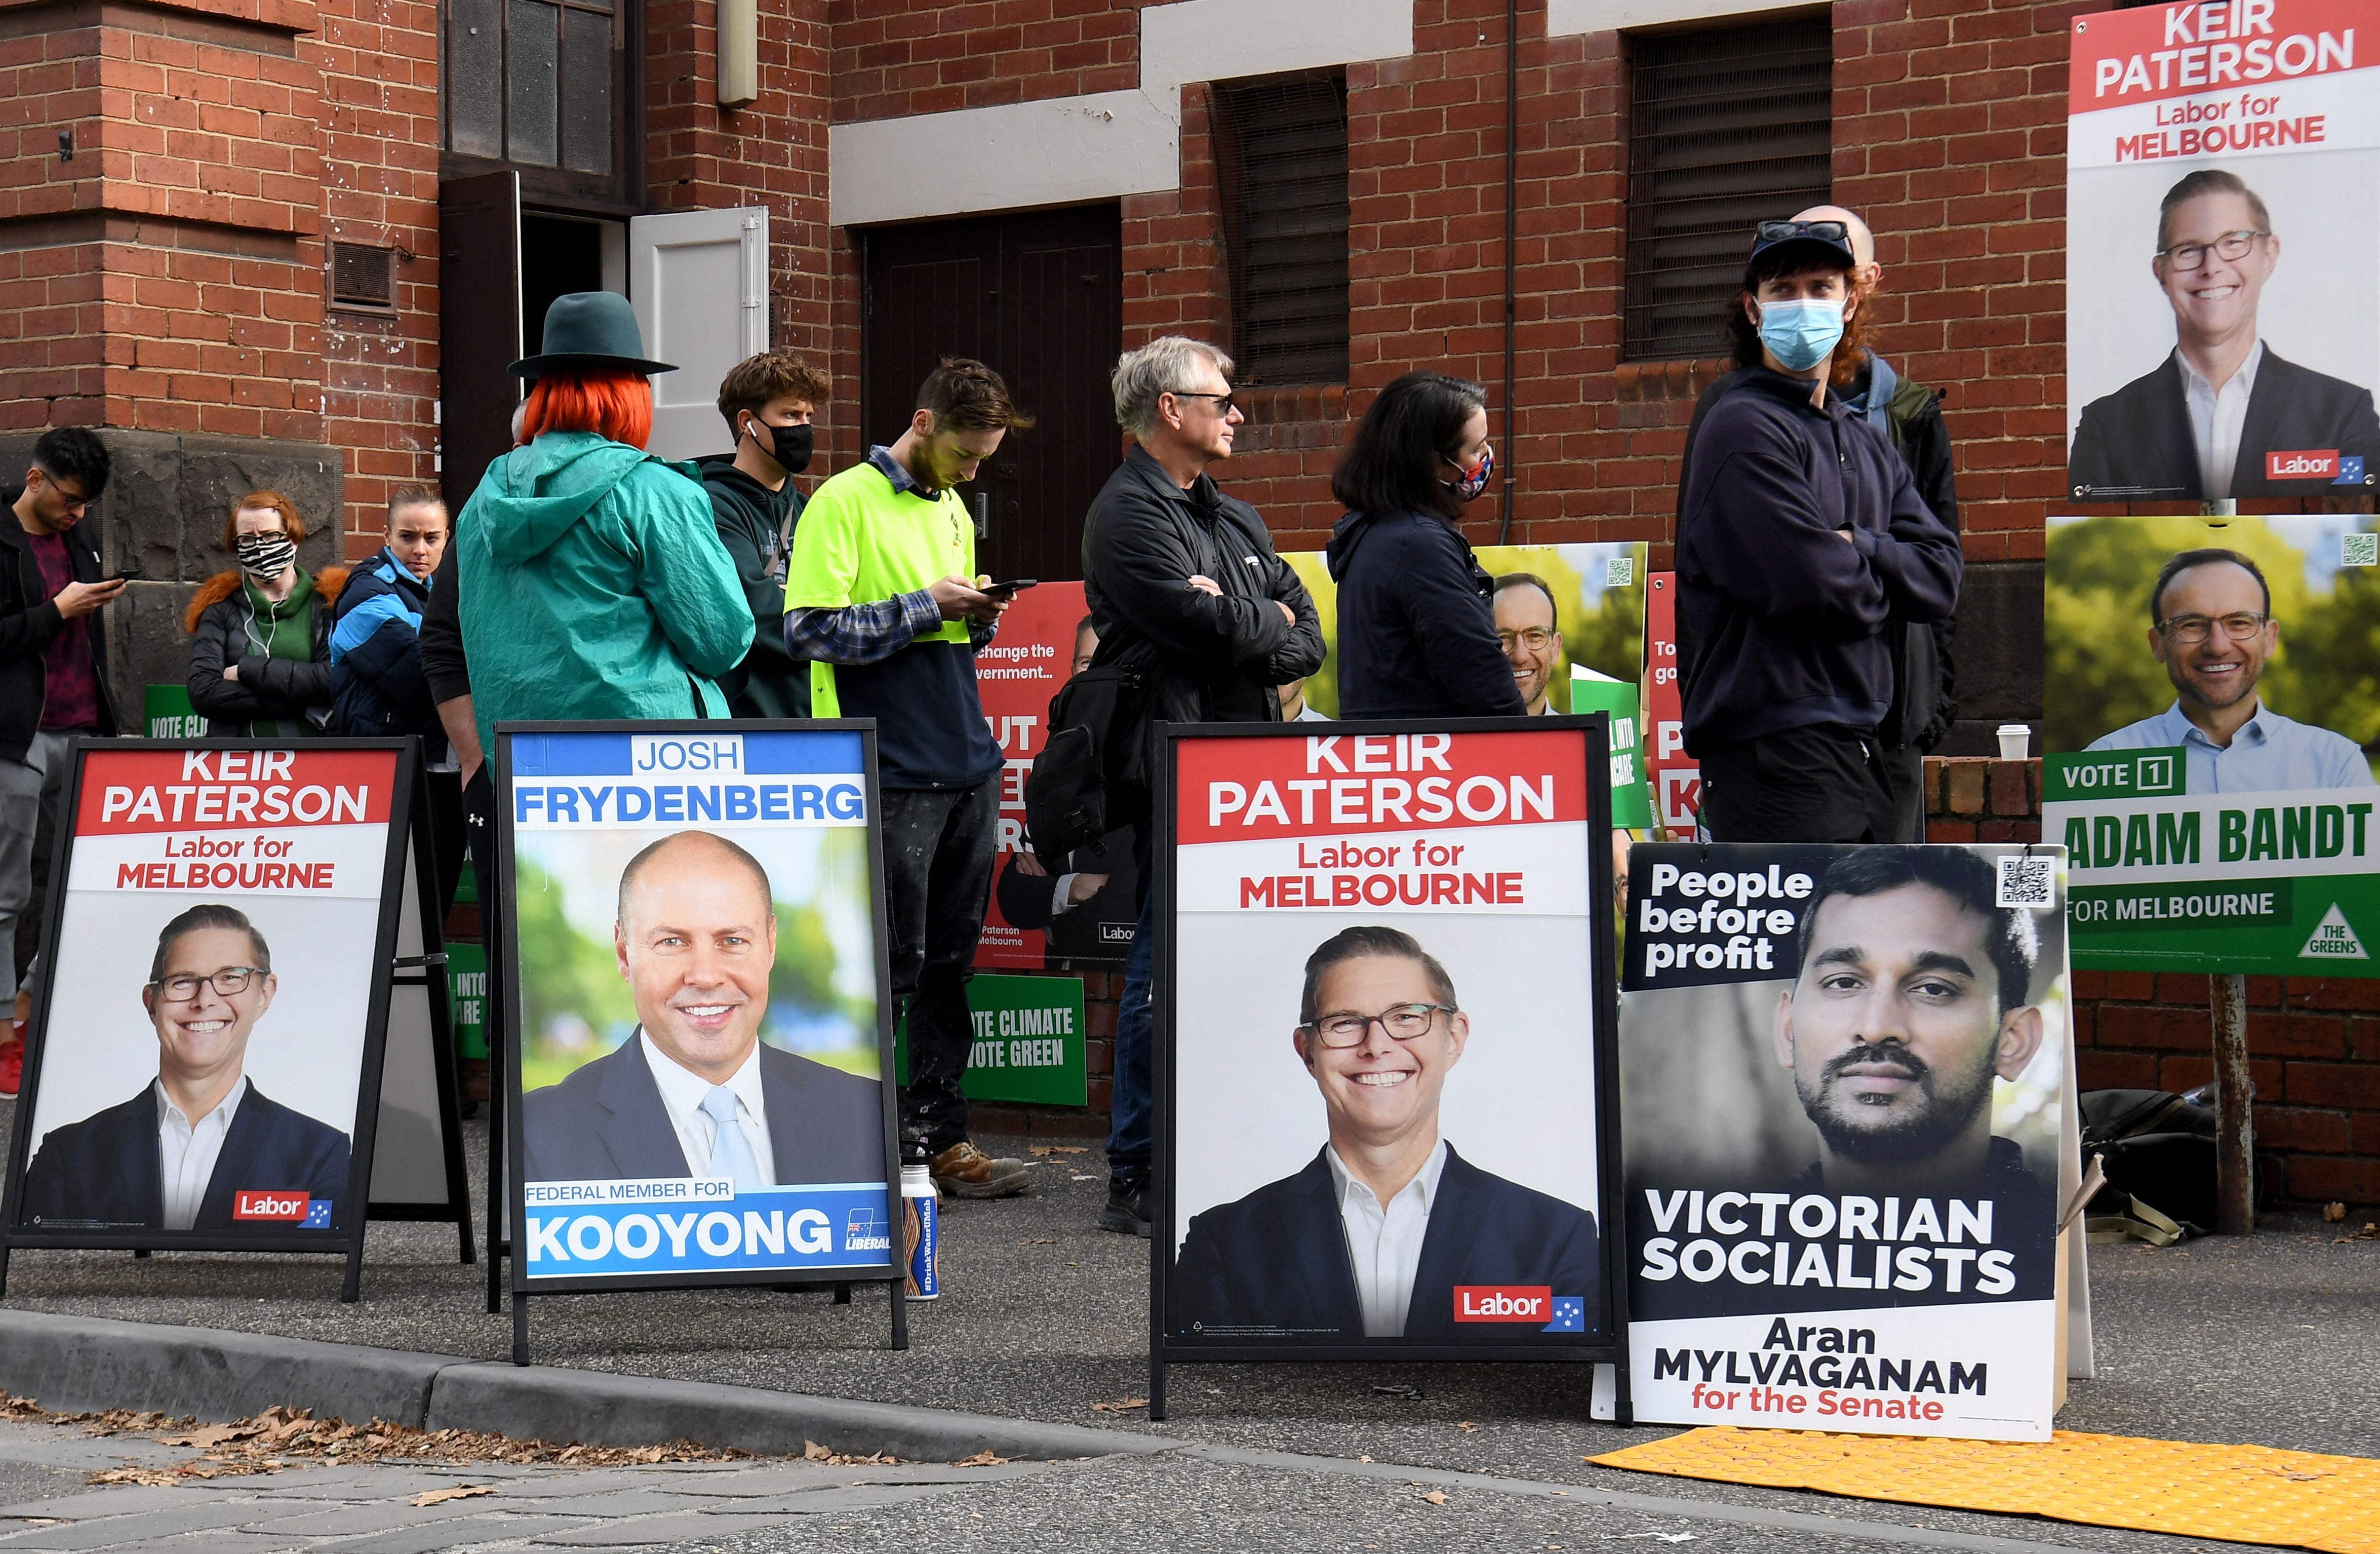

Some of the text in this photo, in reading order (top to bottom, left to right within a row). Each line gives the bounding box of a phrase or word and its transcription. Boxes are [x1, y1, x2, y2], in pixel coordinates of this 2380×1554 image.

[2164, 0, 2275, 47] KEIR
[2095, 28, 2355, 98] PATERSON
[2156, 94, 2280, 127] Labor for
[2116, 114, 2326, 163] MELBOURNE
[2273, 455, 2332, 475] Labor
[1031, 643, 1054, 657] the
[975, 666, 1053, 680] vernment...
[152, 716, 182, 738] VOTE
[984, 716, 1037, 750] UT
[181, 749, 296, 782] KEIR
[637, 741, 739, 771] JOSH
[1306, 733, 1452, 775] KEIR
[2062, 763, 2128, 789] VOTE
[101, 784, 369, 824] PATERSON
[515, 783, 864, 823] FRYDENBERG
[1208, 774, 1554, 827] PATERSON
[165, 835, 293, 858] Labor for
[2064, 803, 2373, 869] ADAM BANDT
[1298, 838, 1464, 869] Labor for
[116, 863, 335, 889] MELBOURNE
[1240, 872, 1524, 909] MELBOURNE
[1651, 864, 1814, 907] People
[1640, 899, 1796, 935] before
[2116, 892, 2274, 920] MELBOURNE
[978, 936, 1023, 946] Melbourne
[981, 925, 1019, 935] Paterson
[1103, 926, 1135, 940] Labo
[2323, 925, 2345, 939] THE
[1645, 935, 1774, 978] profit
[2310, 939, 2356, 954] GREENS
[457, 972, 486, 996] INTO
[999, 1007, 1073, 1036] CLIMATE
[1010, 1039, 1063, 1067] GREEN
[241, 1195, 302, 1215] Labor
[526, 1182, 730, 1201] FEDERAL MEMBER FOR
[1644, 1188, 1993, 1245] VICTORIAN
[527, 1209, 832, 1262] KOOYONG
[845, 1237, 891, 1250] LIBERAL
[924, 1199, 932, 1292] #DrinkWaterUMob
[1639, 1237, 2016, 1296] SOCIALISTS
[1463, 1292, 1542, 1316] Labor
[1762, 1316, 1875, 1355] Aran
[1653, 1347, 1987, 1396] MYLVAGANAM
[1692, 1382, 1944, 1420] for the Senate
